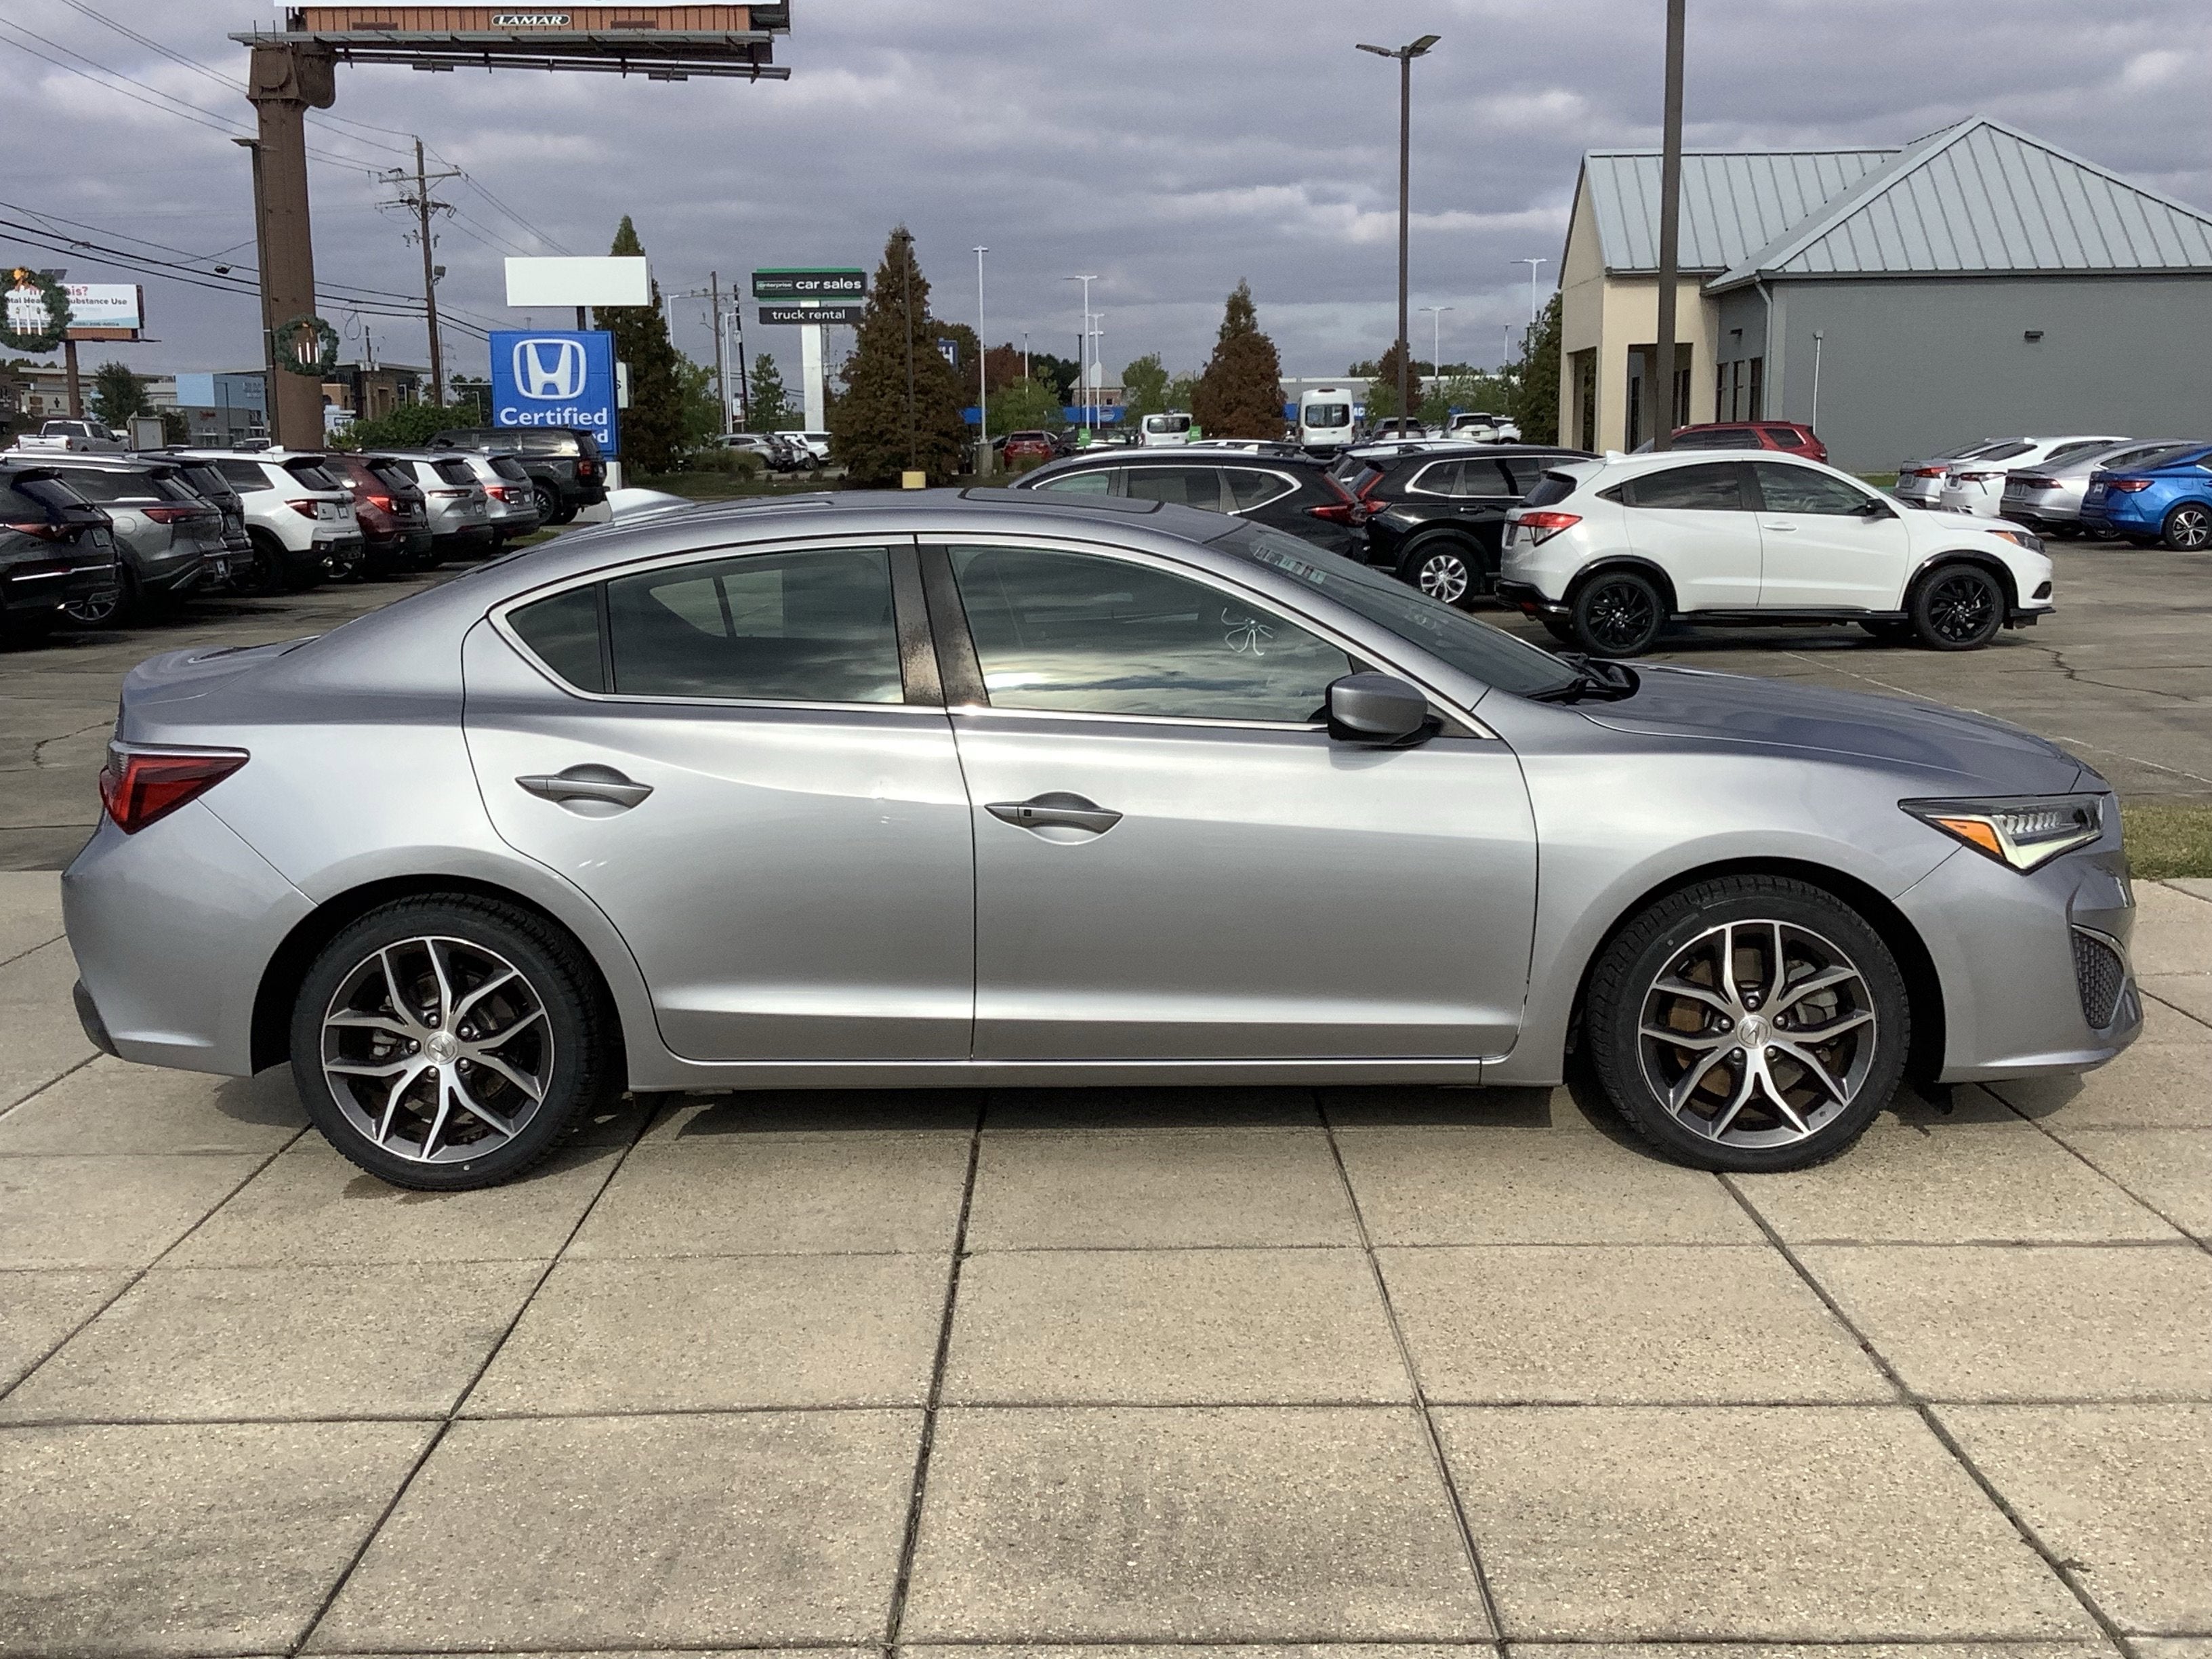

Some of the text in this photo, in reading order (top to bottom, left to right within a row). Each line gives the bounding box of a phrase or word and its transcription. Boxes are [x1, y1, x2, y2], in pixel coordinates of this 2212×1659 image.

[498, 16, 562, 24] LAMAR
[796, 281, 820, 289] car
[823, 278, 861, 289] sales
[772, 309, 846, 319] truck rental
[499, 407, 608, 425] Certified
